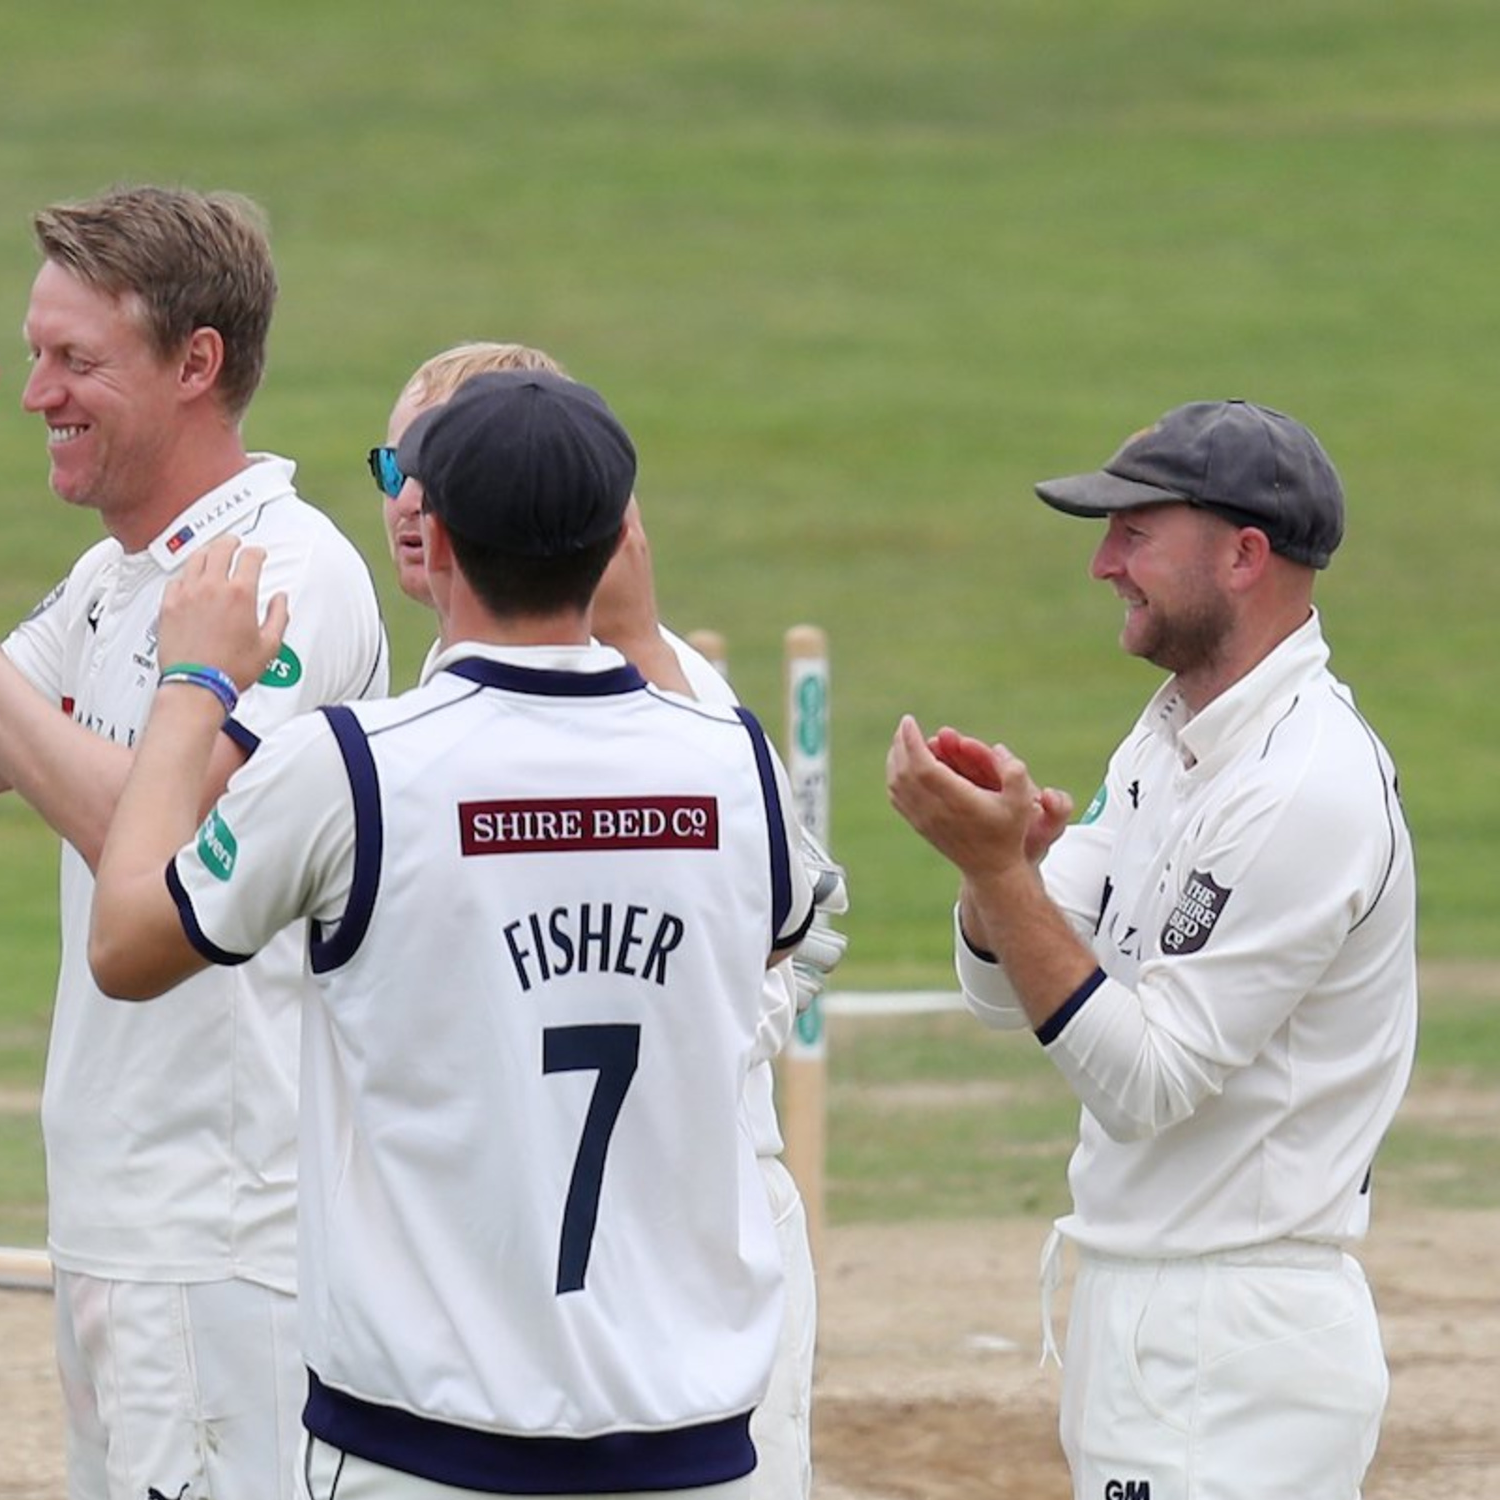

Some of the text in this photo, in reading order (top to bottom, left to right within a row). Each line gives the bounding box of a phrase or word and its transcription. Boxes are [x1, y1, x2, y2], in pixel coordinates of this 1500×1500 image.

[193, 487, 252, 531] MAZARS
[473, 810, 583, 843] SHIRE
[592, 808, 667, 838] BED
[1186, 878, 1217, 909] THE
[1168, 909, 1200, 939] BED
[502, 902, 685, 993] FISHER
[542, 1022, 642, 1296] 7
